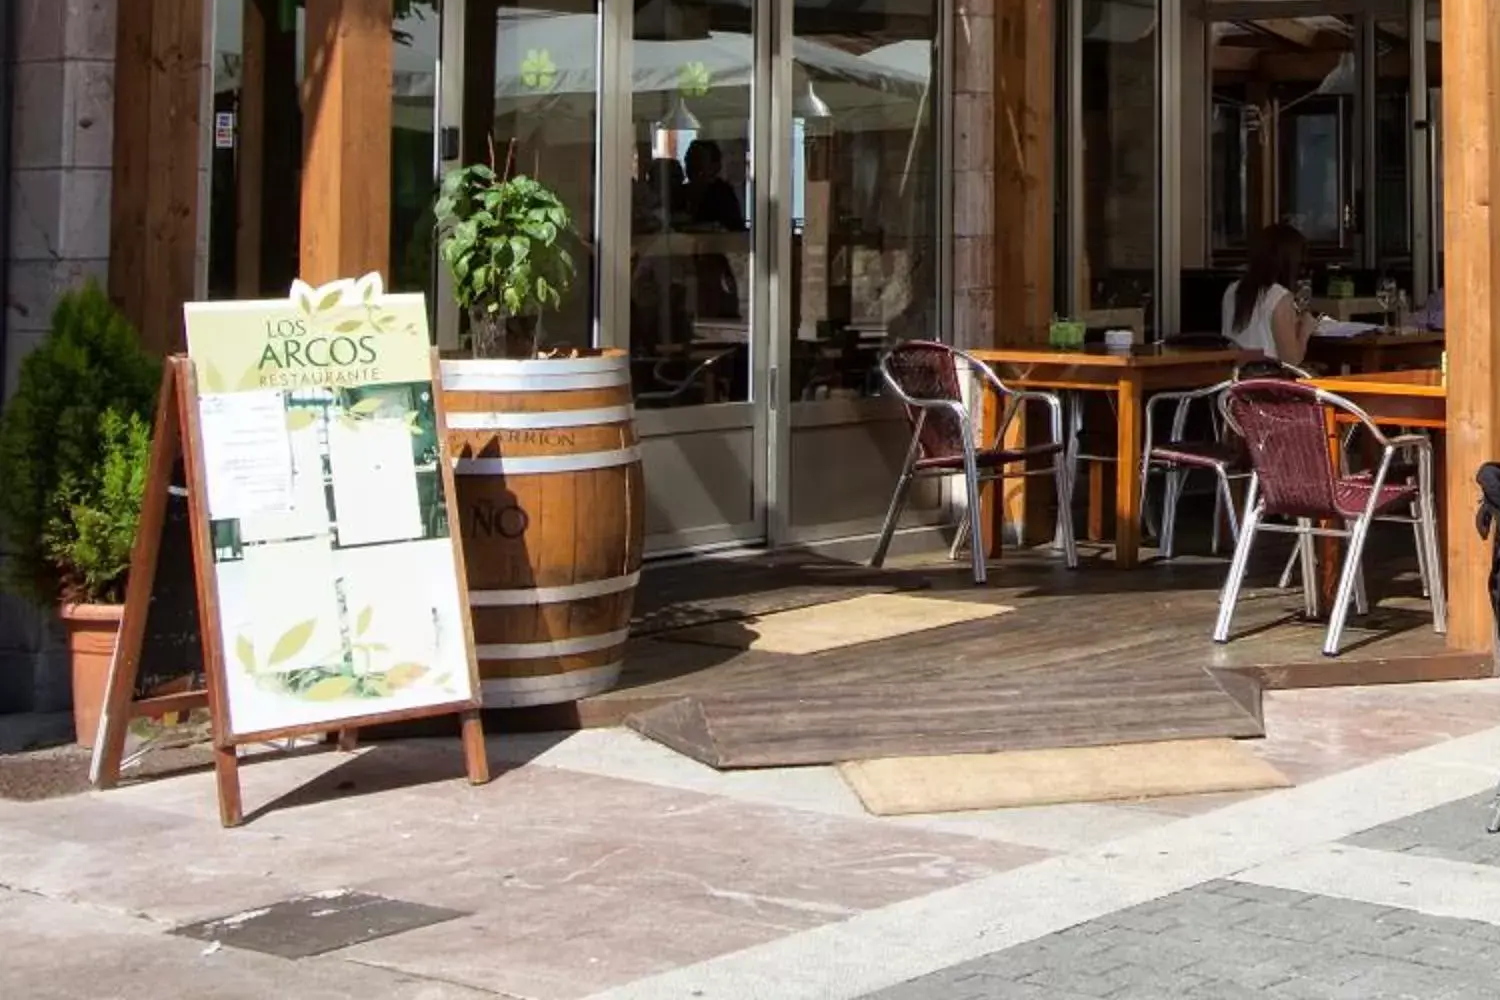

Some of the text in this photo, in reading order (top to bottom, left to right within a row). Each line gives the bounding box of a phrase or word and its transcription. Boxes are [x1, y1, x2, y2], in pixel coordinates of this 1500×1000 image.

[267, 319, 307, 339] LOS
[258, 335, 378, 371] ARCOS
[259, 367, 382, 388] RESTAURANTE
